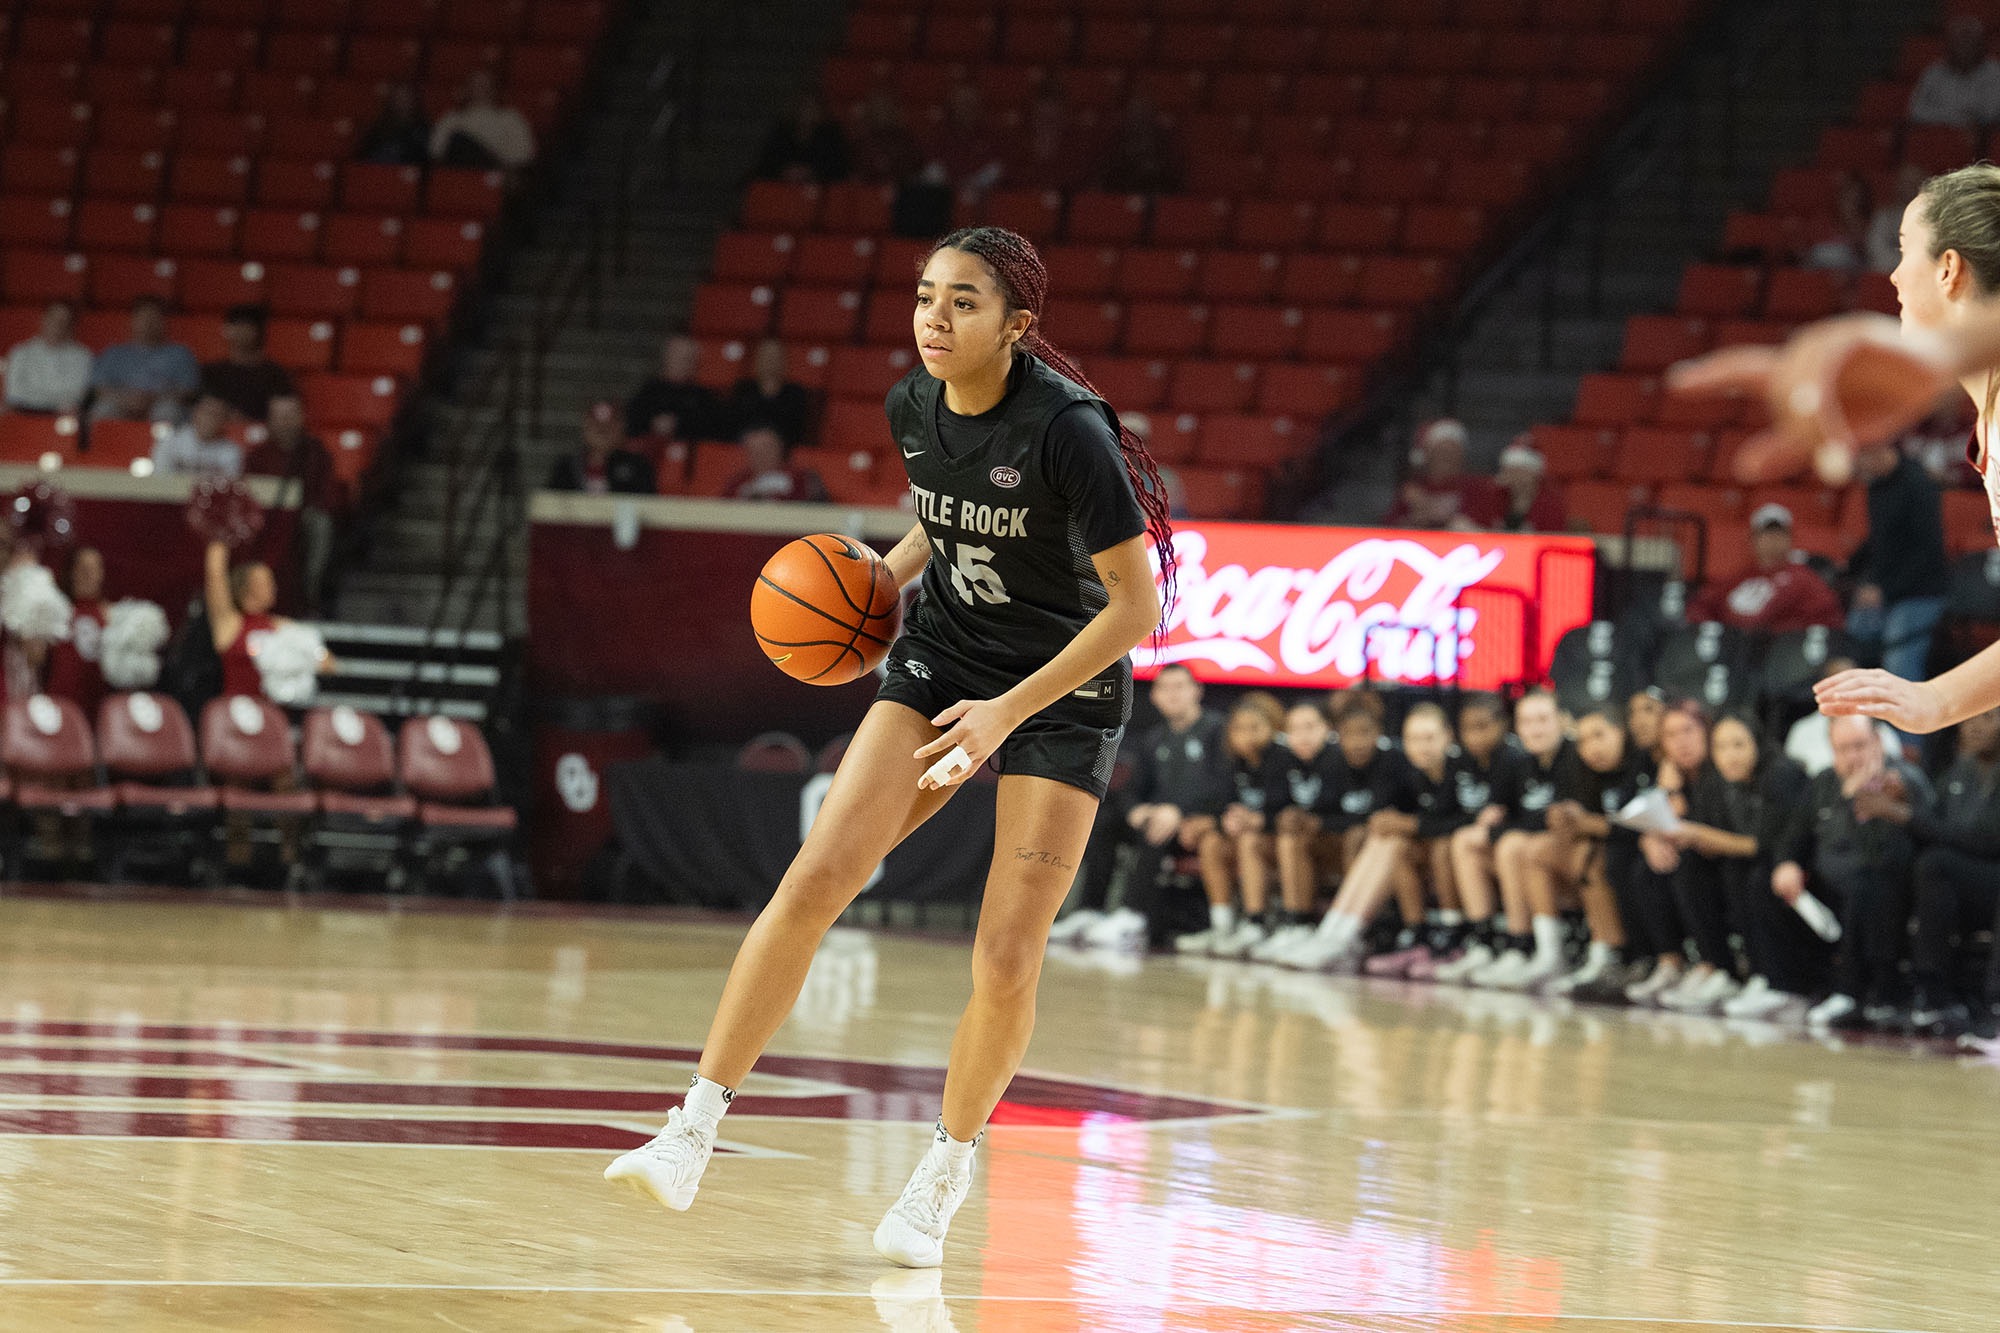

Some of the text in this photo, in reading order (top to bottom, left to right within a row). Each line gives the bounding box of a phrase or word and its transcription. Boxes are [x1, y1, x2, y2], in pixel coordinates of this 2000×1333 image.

[996, 472, 1015, 482] OVC
[910, 482, 1030, 537] TTLE ROCK
[931, 536, 1011, 606] 15
[1103, 685, 1112, 695] M
